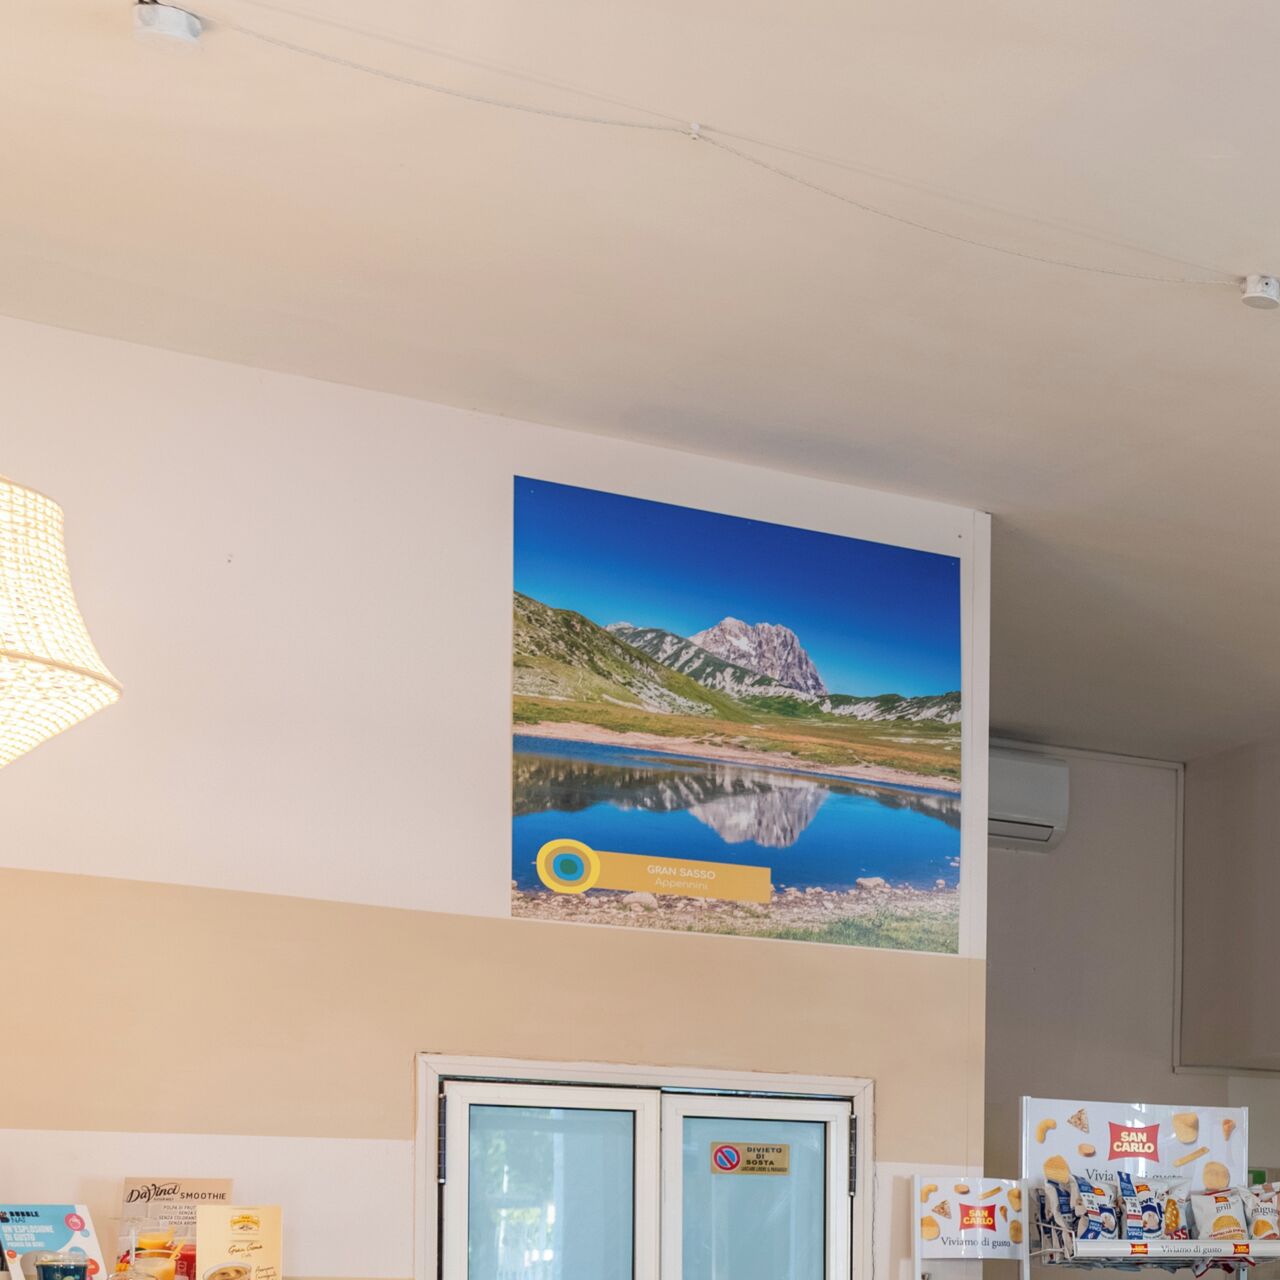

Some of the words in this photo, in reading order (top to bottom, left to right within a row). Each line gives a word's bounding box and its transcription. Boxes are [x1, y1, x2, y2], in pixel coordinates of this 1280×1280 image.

[647, 865, 676, 877] GRAN
[679, 866, 716, 880] SASSO
[1120, 1131, 1147, 1143] SAN
[1112, 1142, 1155, 1155] CARLO
[180, 1192, 227, 1200] SMOOTHIE
[968, 1208, 989, 1217] SAN
[963, 1216, 994, 1225] CARLO
[941, 1236, 980, 1248] Viviamo
[981, 1237, 990, 1247] di
[991, 1240, 1011, 1249] gusto
[1161, 1245, 1191, 1254] Viviamo
[1193, 1245, 1200, 1253] di
[1202, 1246, 1222, 1254] gusto
